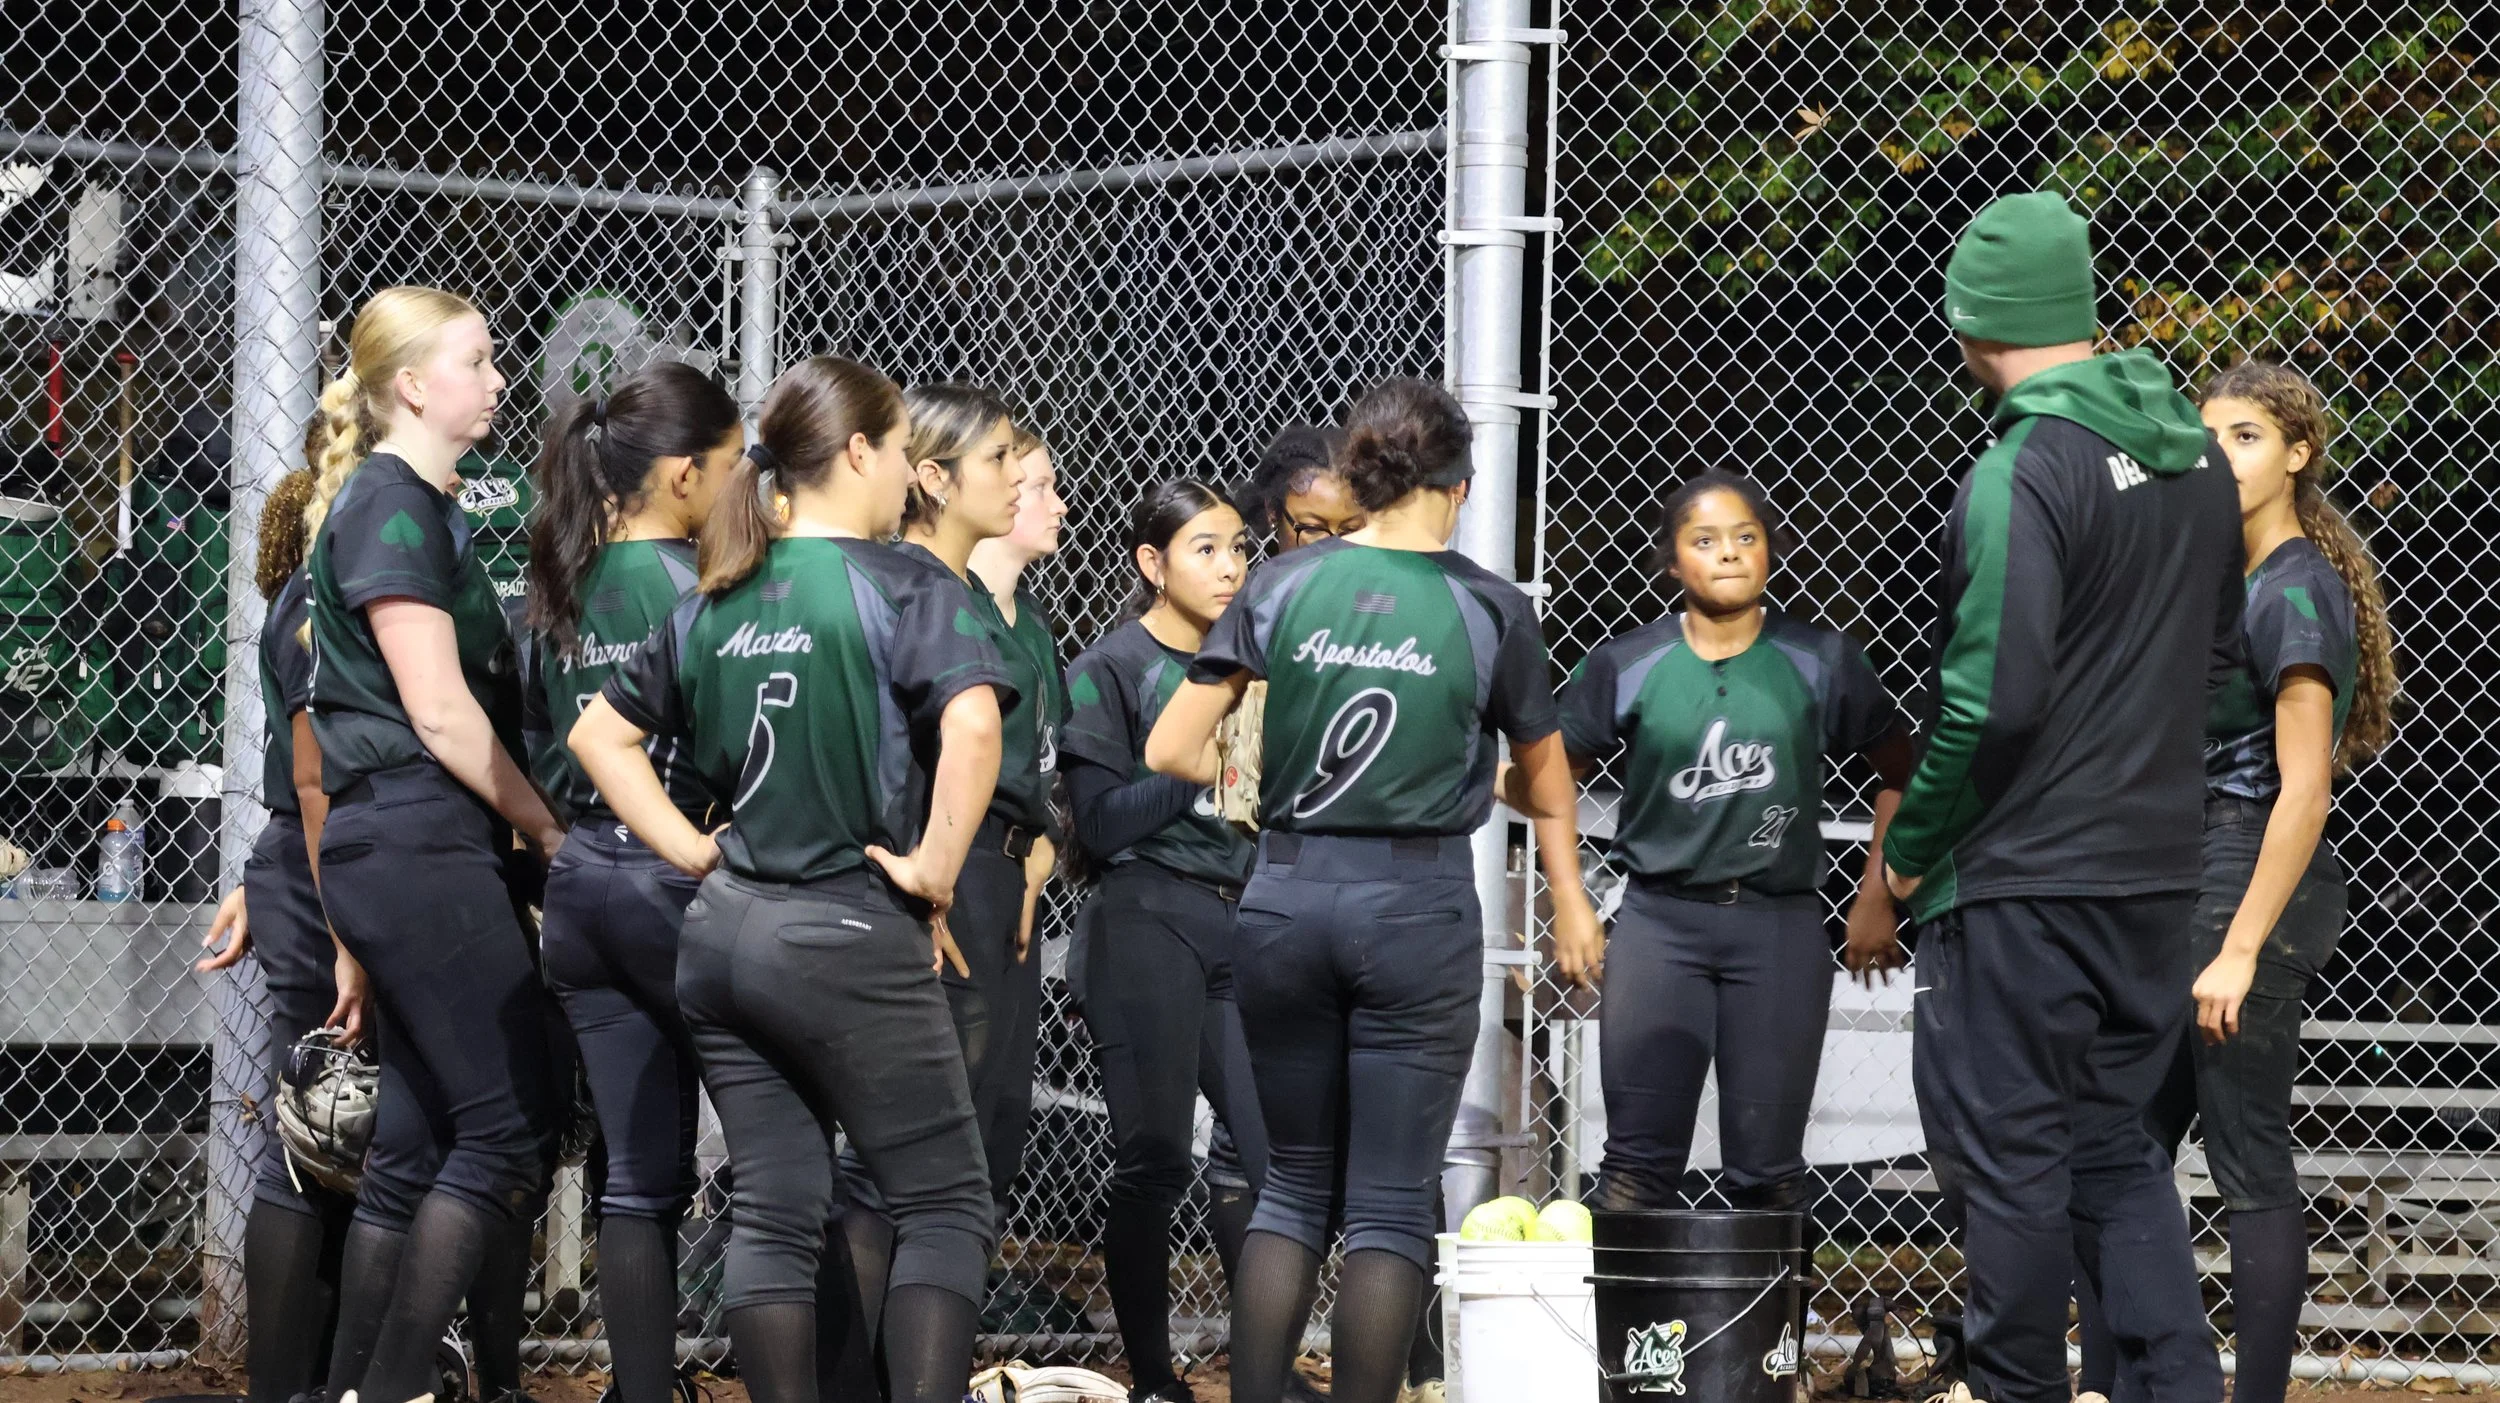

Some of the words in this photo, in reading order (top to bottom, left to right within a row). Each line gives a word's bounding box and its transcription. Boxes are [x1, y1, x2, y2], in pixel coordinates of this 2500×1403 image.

[716, 620, 813, 658] Martin
[1293, 629, 1437, 676] Apostolos
[732, 671, 798, 811] 5
[1292, 687, 1398, 819] 9
[1669, 720, 1775, 803] Aces
[1629, 1336, 1681, 1376] Aces
